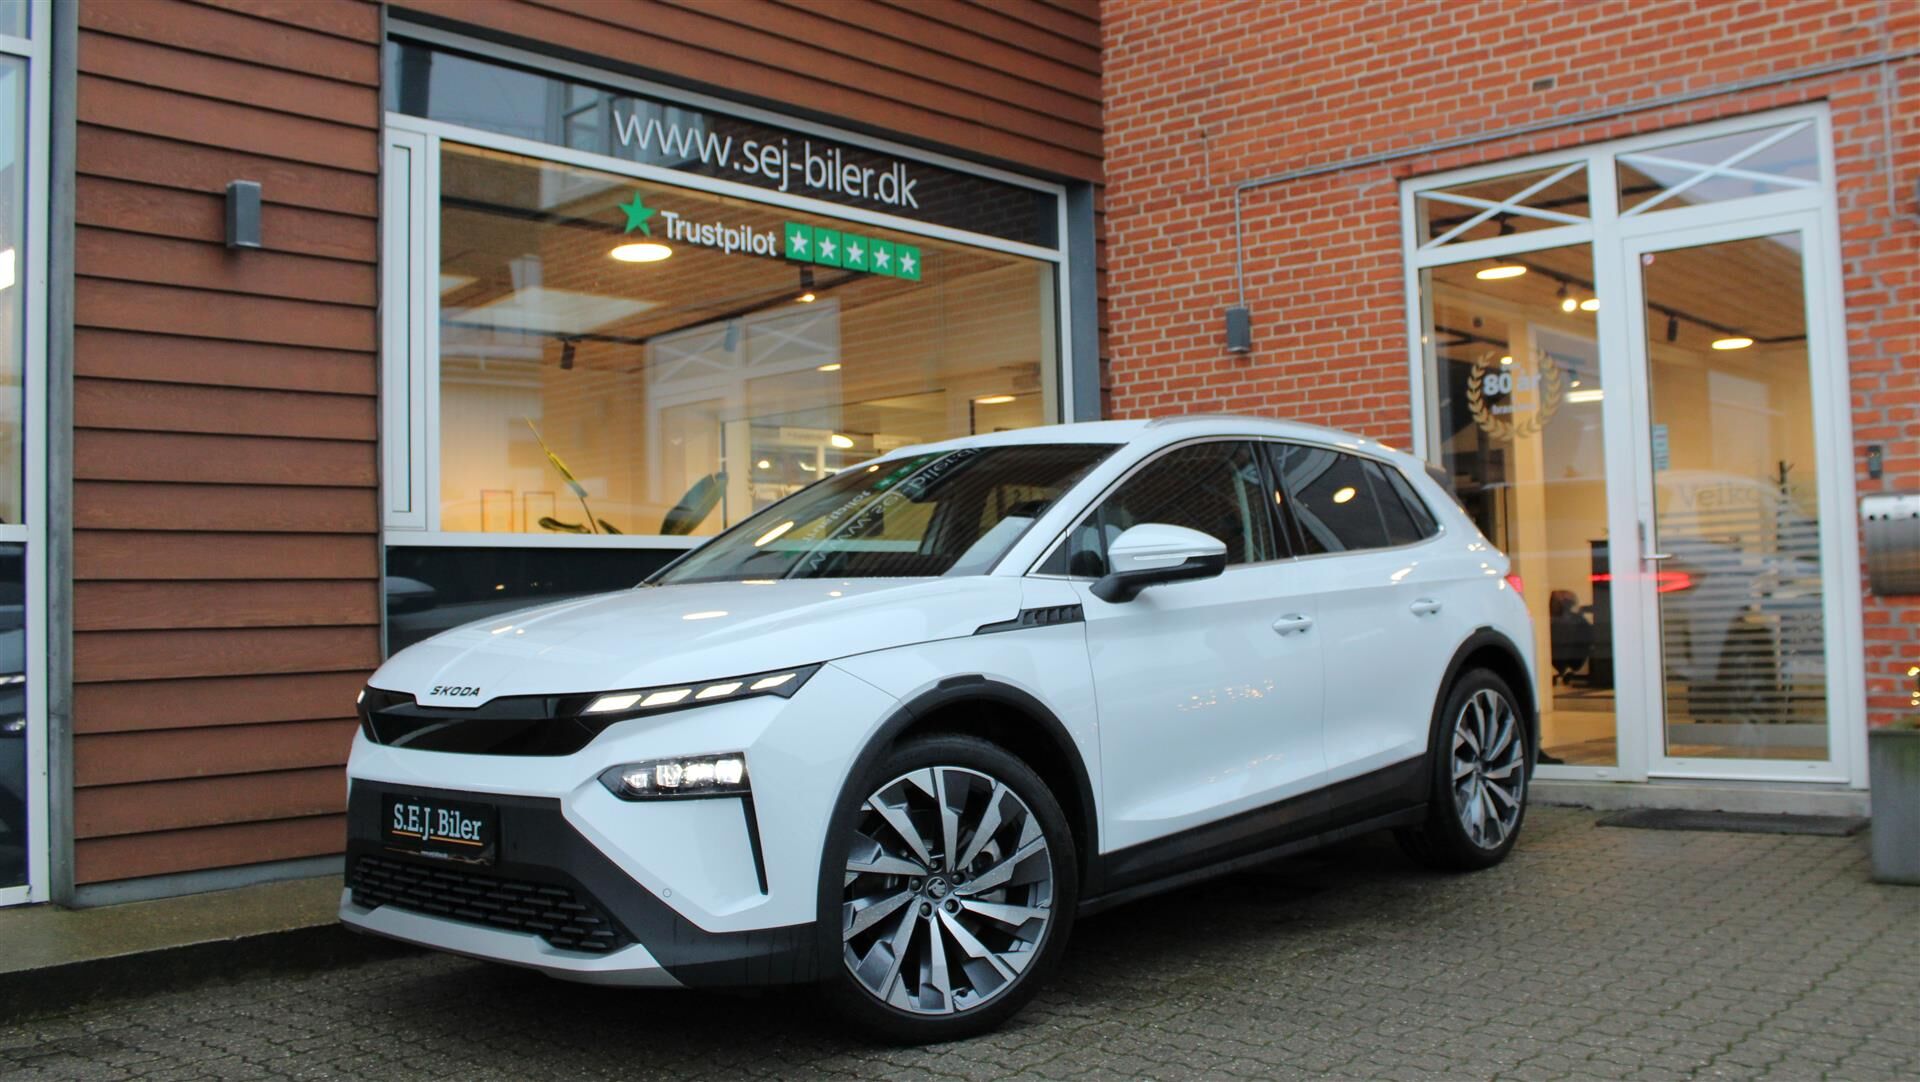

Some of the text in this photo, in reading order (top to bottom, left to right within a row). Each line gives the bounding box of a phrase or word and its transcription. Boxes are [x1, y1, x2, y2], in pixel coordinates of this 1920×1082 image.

[613, 109, 919, 209] www.sej-biler.dk
[660, 210, 777, 256] Trustpilot
[1483, 373, 1513, 396] 80
[393, 803, 482, 841] S.E.J. Biler
